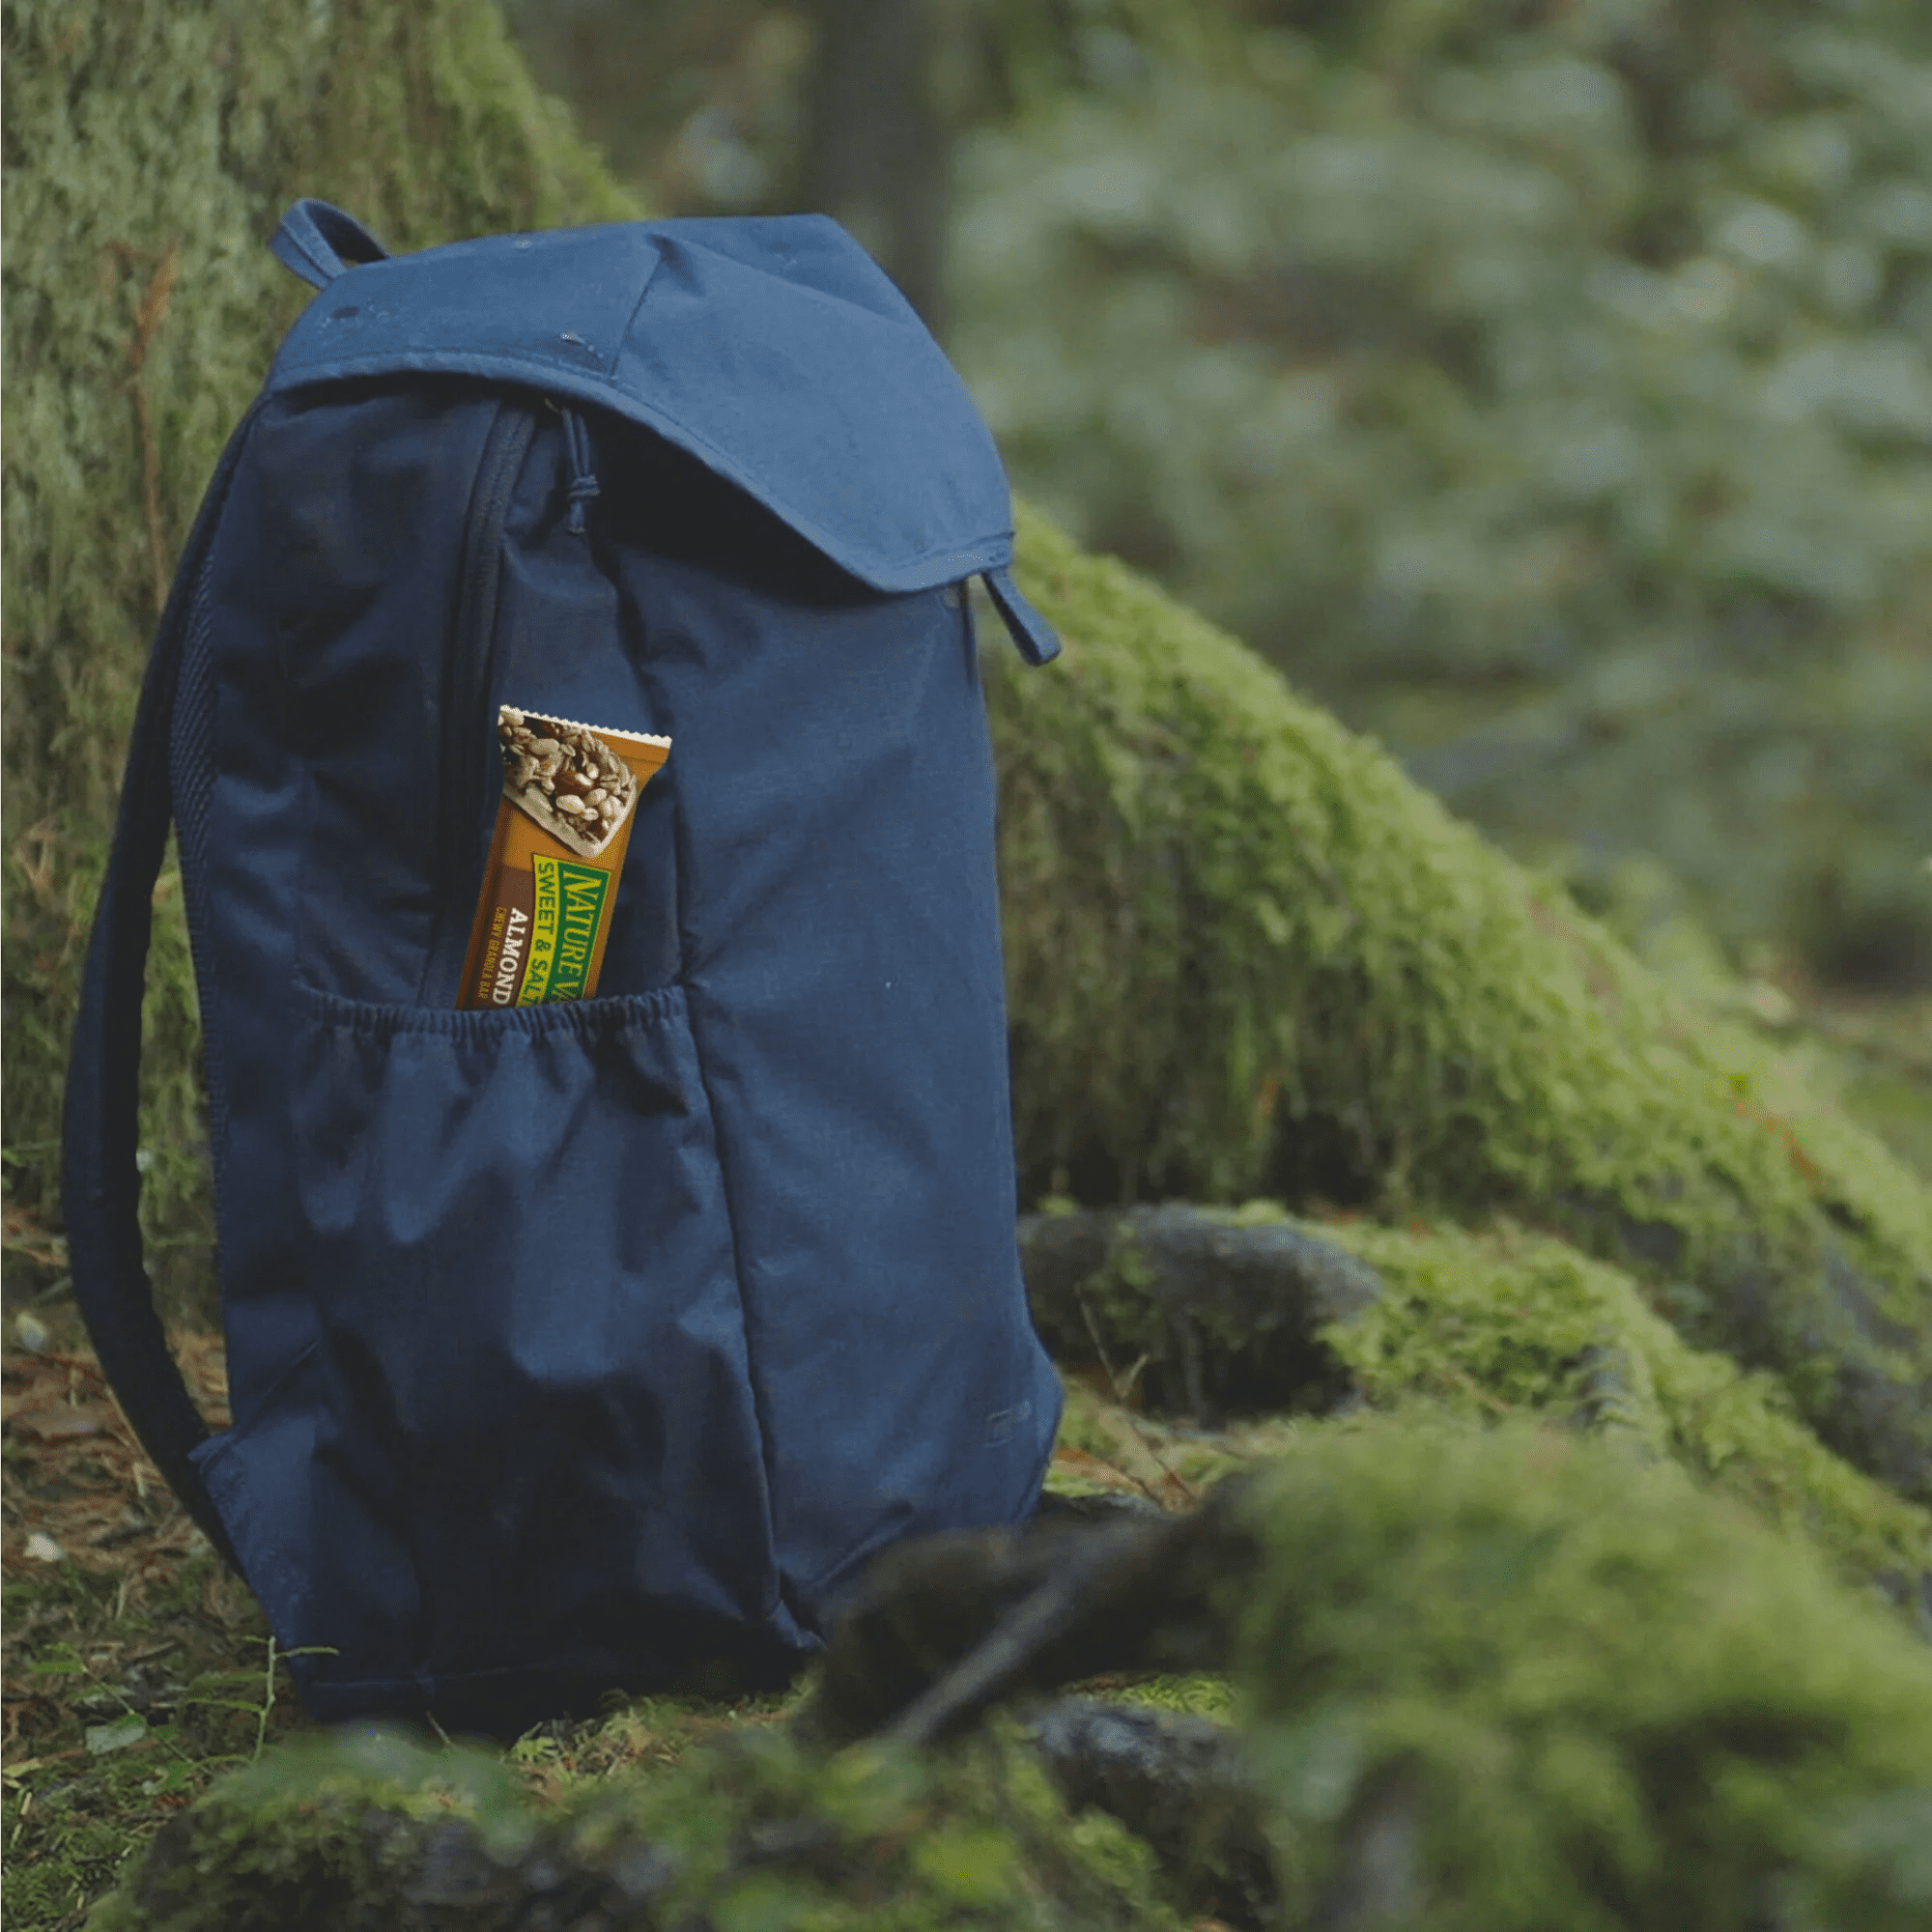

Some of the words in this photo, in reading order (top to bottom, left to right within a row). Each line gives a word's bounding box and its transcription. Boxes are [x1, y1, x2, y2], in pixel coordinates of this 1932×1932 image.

[537, 862, 555, 935] SWEET
[557, 869, 602, 977] NATURE
[492, 907, 528, 1005] ALMOND
[534, 938, 552, 952] &
